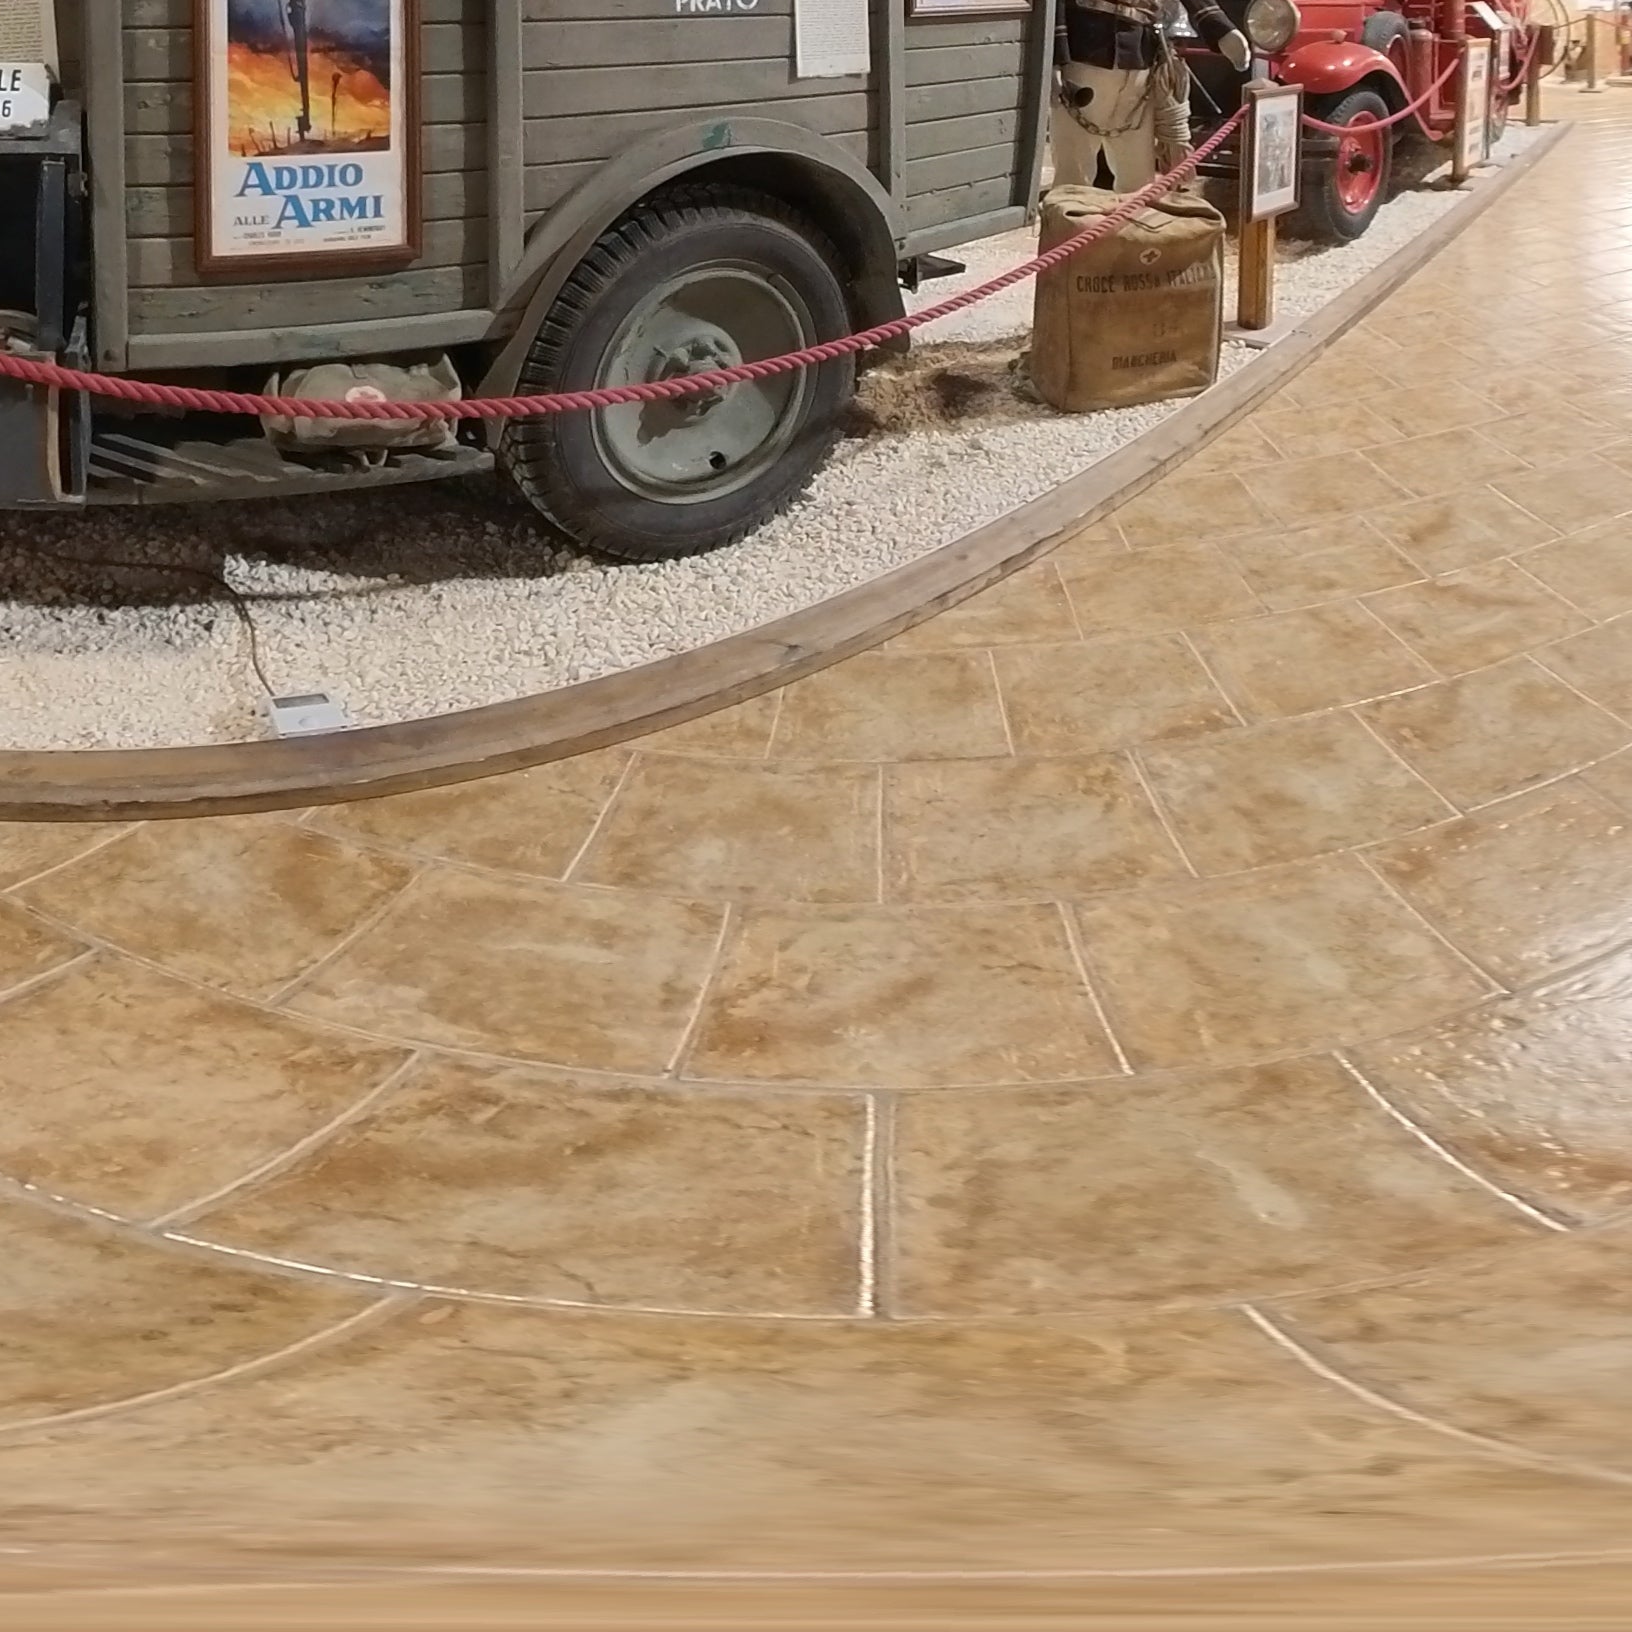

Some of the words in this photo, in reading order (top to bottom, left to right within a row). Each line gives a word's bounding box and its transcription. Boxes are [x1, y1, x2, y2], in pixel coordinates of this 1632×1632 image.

[233, 161, 363, 197] ADDIO
[233, 215, 270, 226] ALLE
[271, 194, 385, 230] ARMI
[1077, 274, 1115, 293] CROCE
